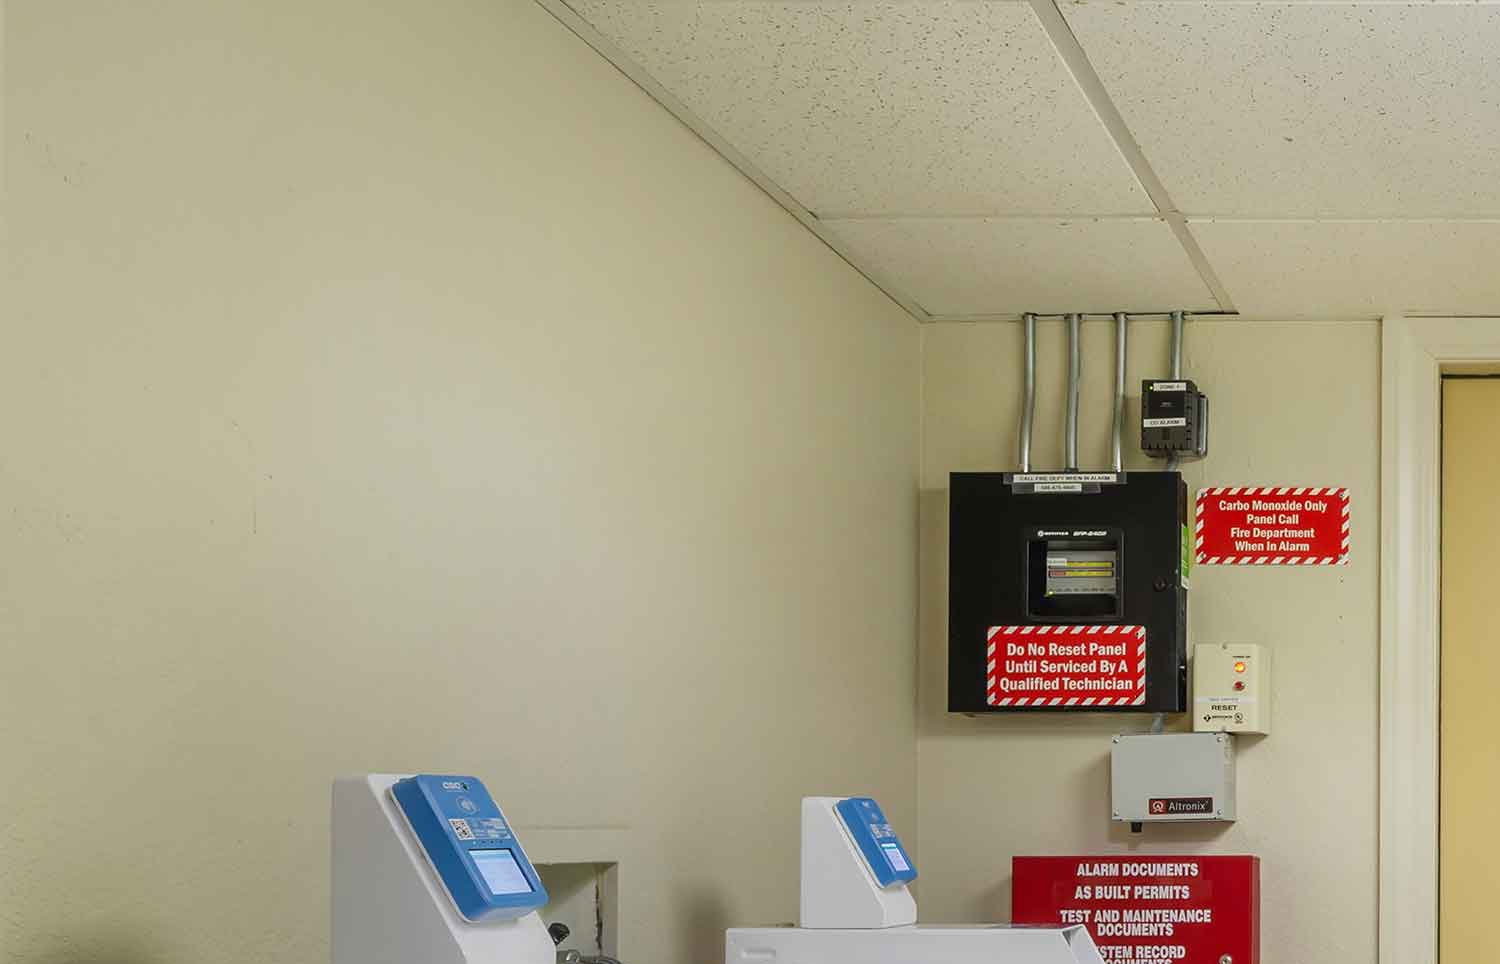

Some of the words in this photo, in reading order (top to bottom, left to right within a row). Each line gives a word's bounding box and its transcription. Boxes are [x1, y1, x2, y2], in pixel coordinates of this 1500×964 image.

[1219, 500, 1249, 511] Carbo
[1252, 500, 1302, 511] Monoxide
[1305, 500, 1327, 513] Only
[1247, 514, 1276, 524] Panel
[1278, 514, 1299, 524] Call
[1231, 527, 1250, 538] Fire
[1253, 527, 1315, 540] Department
[1235, 541, 1264, 551] When
[1267, 541, 1276, 551] In
[1278, 541, 1310, 551] Alarm
[1007, 643, 1024, 656] Do
[1028, 643, 1045, 656] No
[1049, 643, 1086, 656] Reset
[1089, 643, 1126, 656] Panel
[1005, 660, 1037, 673] Until
[1040, 660, 1096, 673] Serviced
[1100, 660, 1116, 676] By
[1118, 660, 1128, 673] A
[1000, 677, 1059, 692] Qualified
[1062, 677, 1133, 690] Technician
[1168, 801, 1206, 811] Altronix
[1077, 863, 1119, 876] ALARM
[1122, 863, 1199, 876] DOCUMENTS
[1074, 886, 1091, 899] AS
[1095, 886, 1131, 899] BUILT
[1134, 886, 1190, 899] PERMITS
[1060, 910, 1091, 922] TEST
[1094, 909, 1120, 922] AND
[1123, 909, 1212, 922] MAINTENANCE
[1097, 923, 1174, 936] DOCUMENTS
[1097, 945, 1132, 959] STEM
[1136, 945, 1186, 959] RECORD
